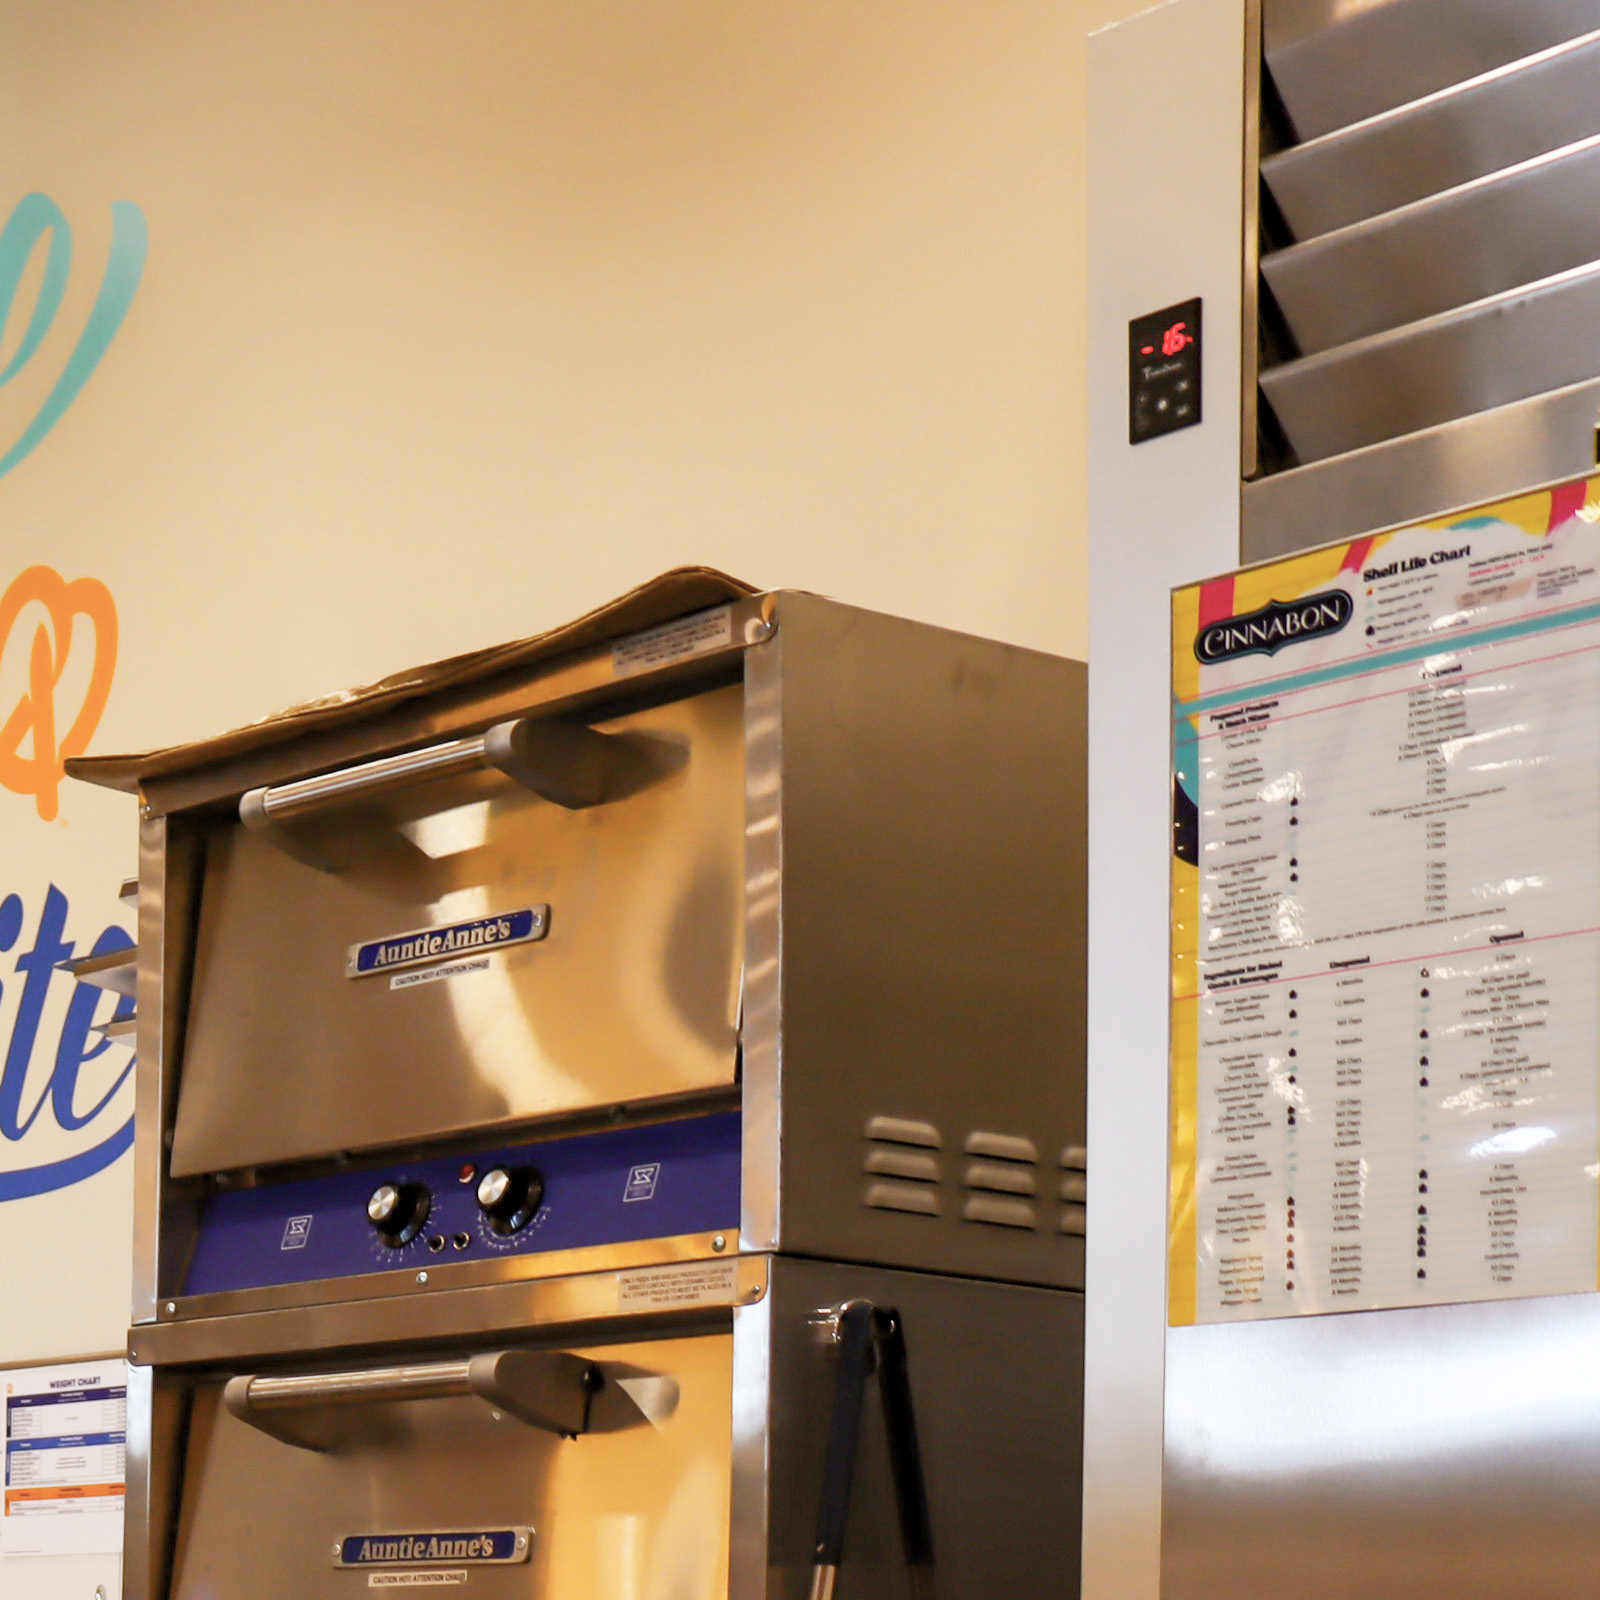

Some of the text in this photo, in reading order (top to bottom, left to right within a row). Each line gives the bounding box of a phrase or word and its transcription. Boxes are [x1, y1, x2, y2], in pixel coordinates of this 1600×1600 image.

[1363, 563, 1398, 583] Shelf
[1401, 558, 1427, 573] Life
[1430, 544, 1471, 565] Chart
[1204, 600, 1340, 656] CINNABON
